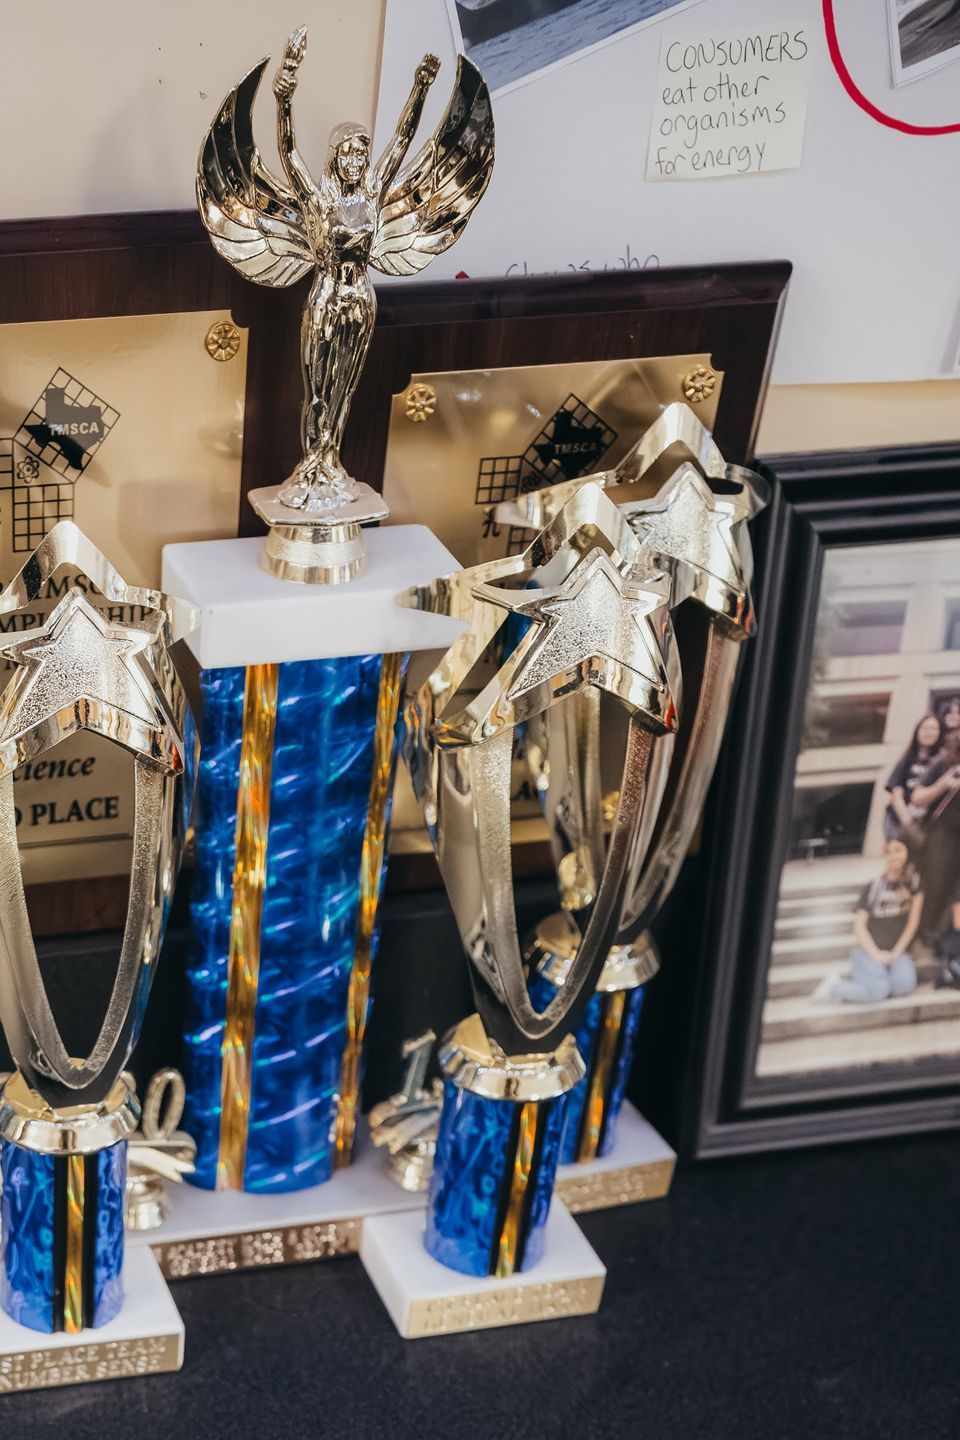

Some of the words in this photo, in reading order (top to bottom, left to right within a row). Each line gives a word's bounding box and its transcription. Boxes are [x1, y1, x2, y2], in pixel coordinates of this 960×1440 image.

[666, 30, 808, 73] CONSUMERS
[662, 77, 697, 105] eat
[704, 72, 770, 103] other
[660, 102, 786, 149] organisms
[655, 147, 686, 175] for
[692, 142, 766, 173] energy
[48, 422, 100, 437] TMSCA
[553, 442, 597, 455] TMSCA
[31, 796, 120, 826] PLACE
[30, 1345, 99, 1369] PLACE
[105, 1336, 167, 1359] TEAM
[95, 1354, 162, 1379] SENSE
